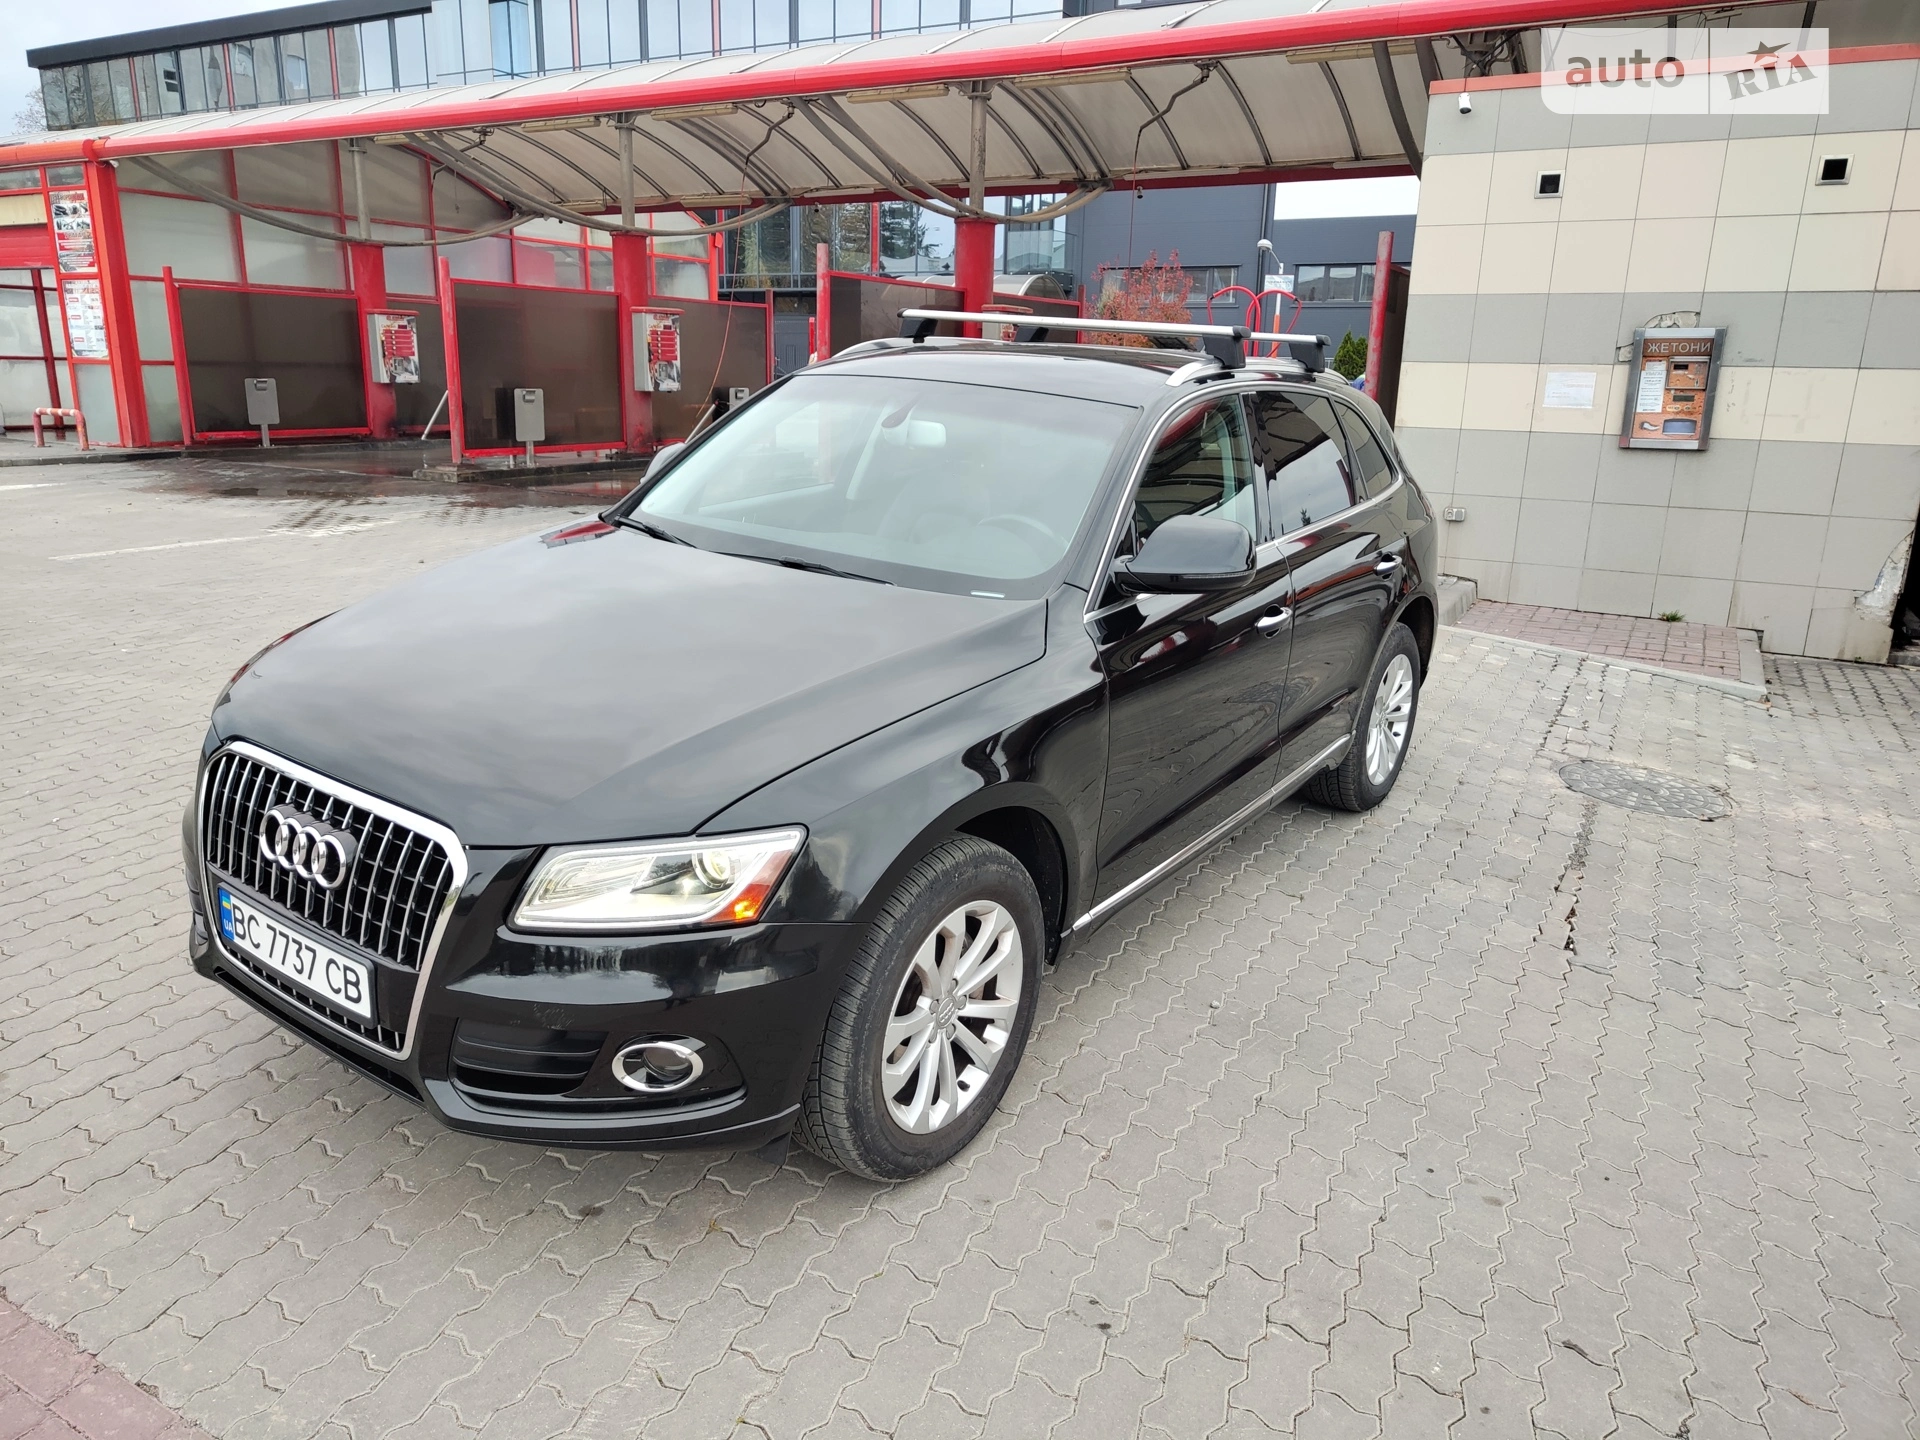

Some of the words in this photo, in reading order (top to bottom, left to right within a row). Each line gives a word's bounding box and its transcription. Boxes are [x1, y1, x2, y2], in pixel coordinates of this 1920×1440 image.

[1647, 342, 1711, 353] ЖЕТОНИ
[223, 919, 233, 933] UA
[232, 903, 261, 949] BC
[266, 923, 317, 980] 7737
[326, 958, 362, 1004] CB
